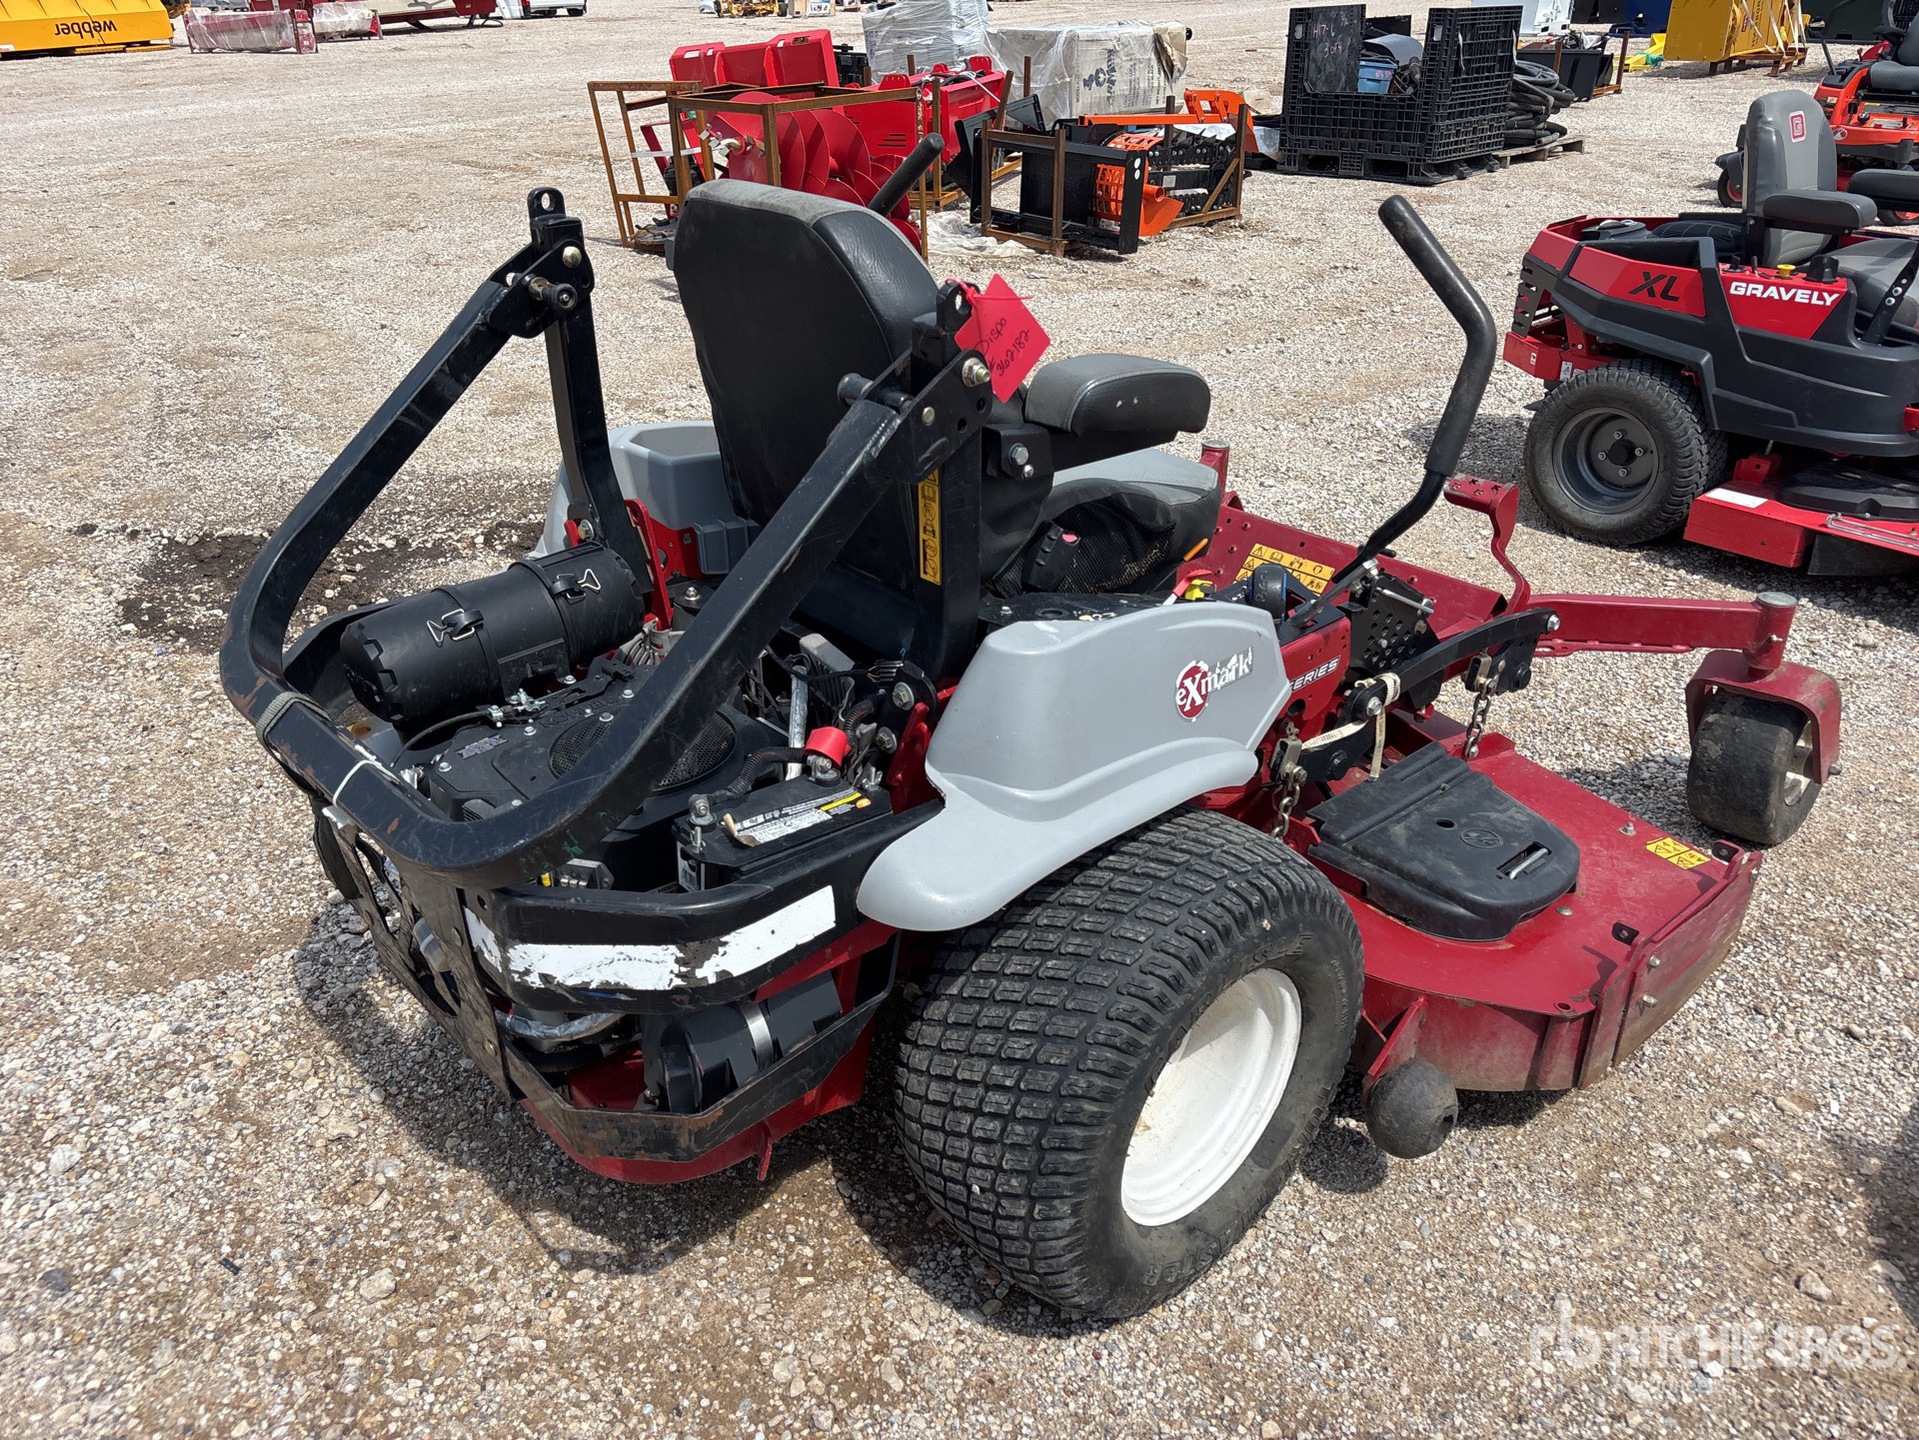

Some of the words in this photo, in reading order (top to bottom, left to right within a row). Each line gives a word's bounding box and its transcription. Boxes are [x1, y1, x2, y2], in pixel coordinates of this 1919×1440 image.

[54, 20, 117, 39] webber
[1629, 272, 1680, 302] XL
[1730, 281, 1839, 306] GRAVELY
[996, 329, 1030, 377] 362182
